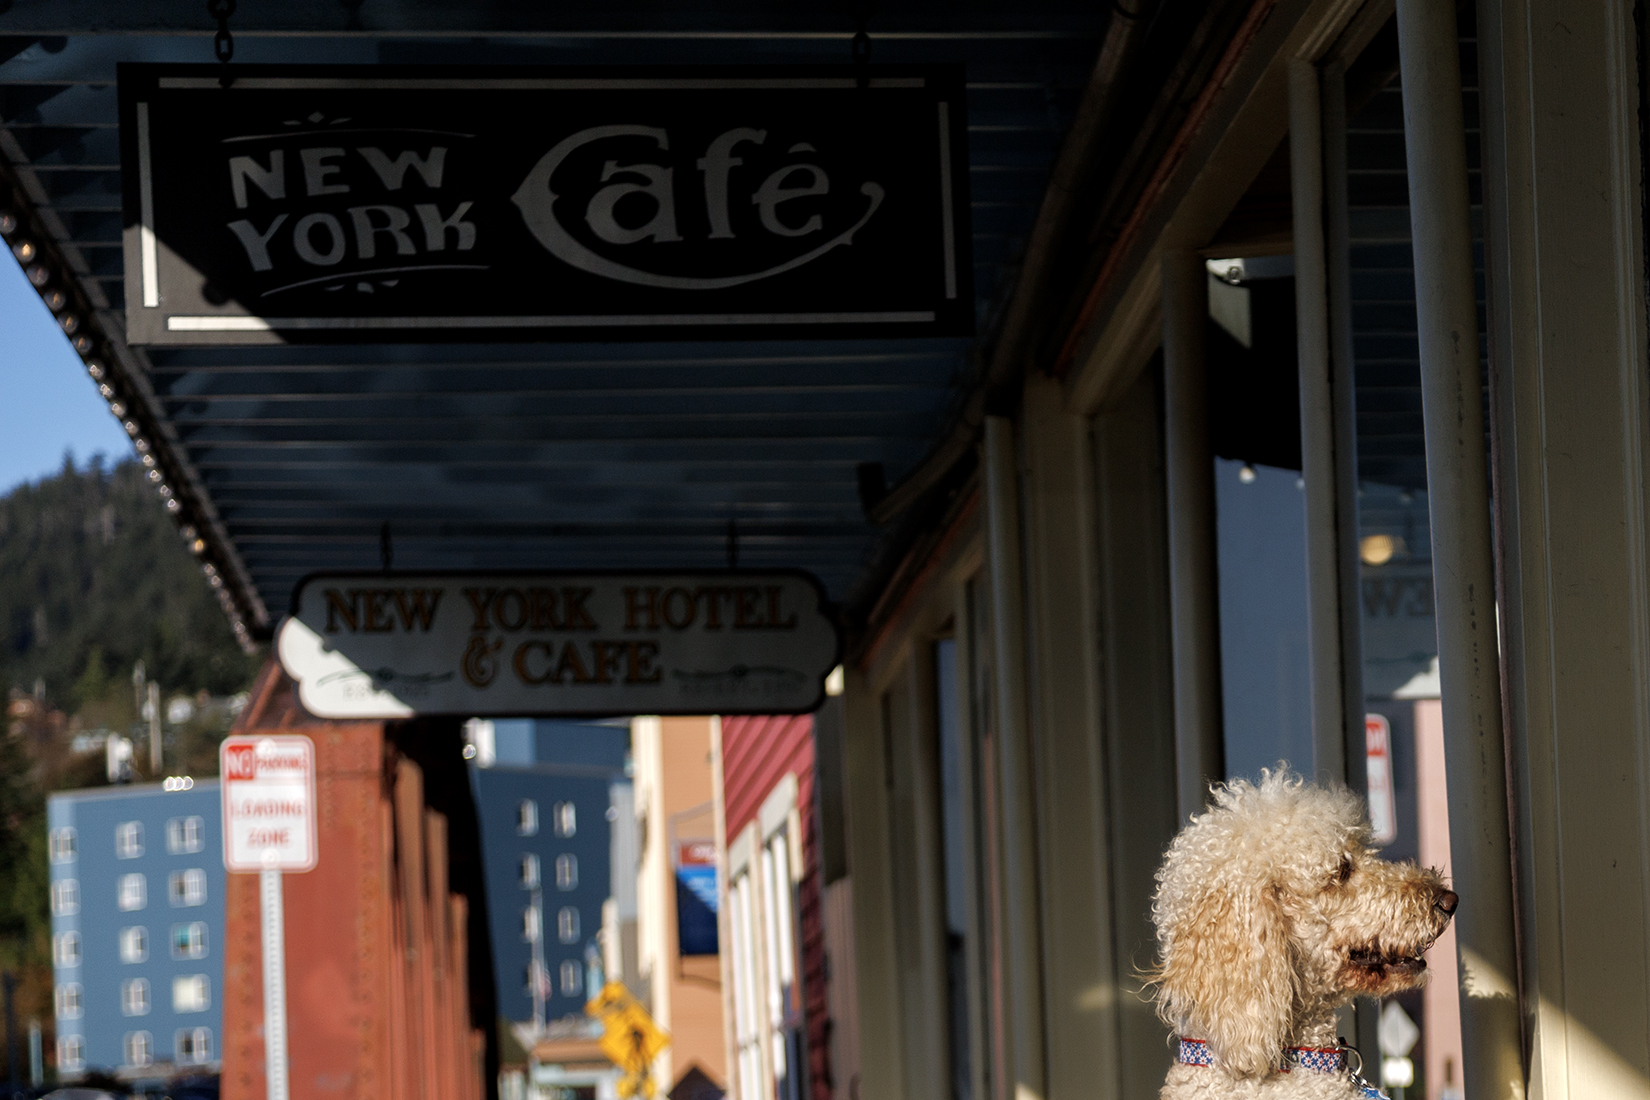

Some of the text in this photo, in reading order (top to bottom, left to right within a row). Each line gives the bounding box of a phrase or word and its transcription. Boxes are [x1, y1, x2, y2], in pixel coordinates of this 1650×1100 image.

[228, 146, 449, 209] NEW
[226, 200, 478, 272] YORK
[323, 586, 797, 634] NEW YORK HOTEL
[461, 637, 664, 688] & CAFE
[227, 748, 254, 778] NO
[231, 799, 305, 818] LOADING
[247, 826, 291, 847] ZONE
